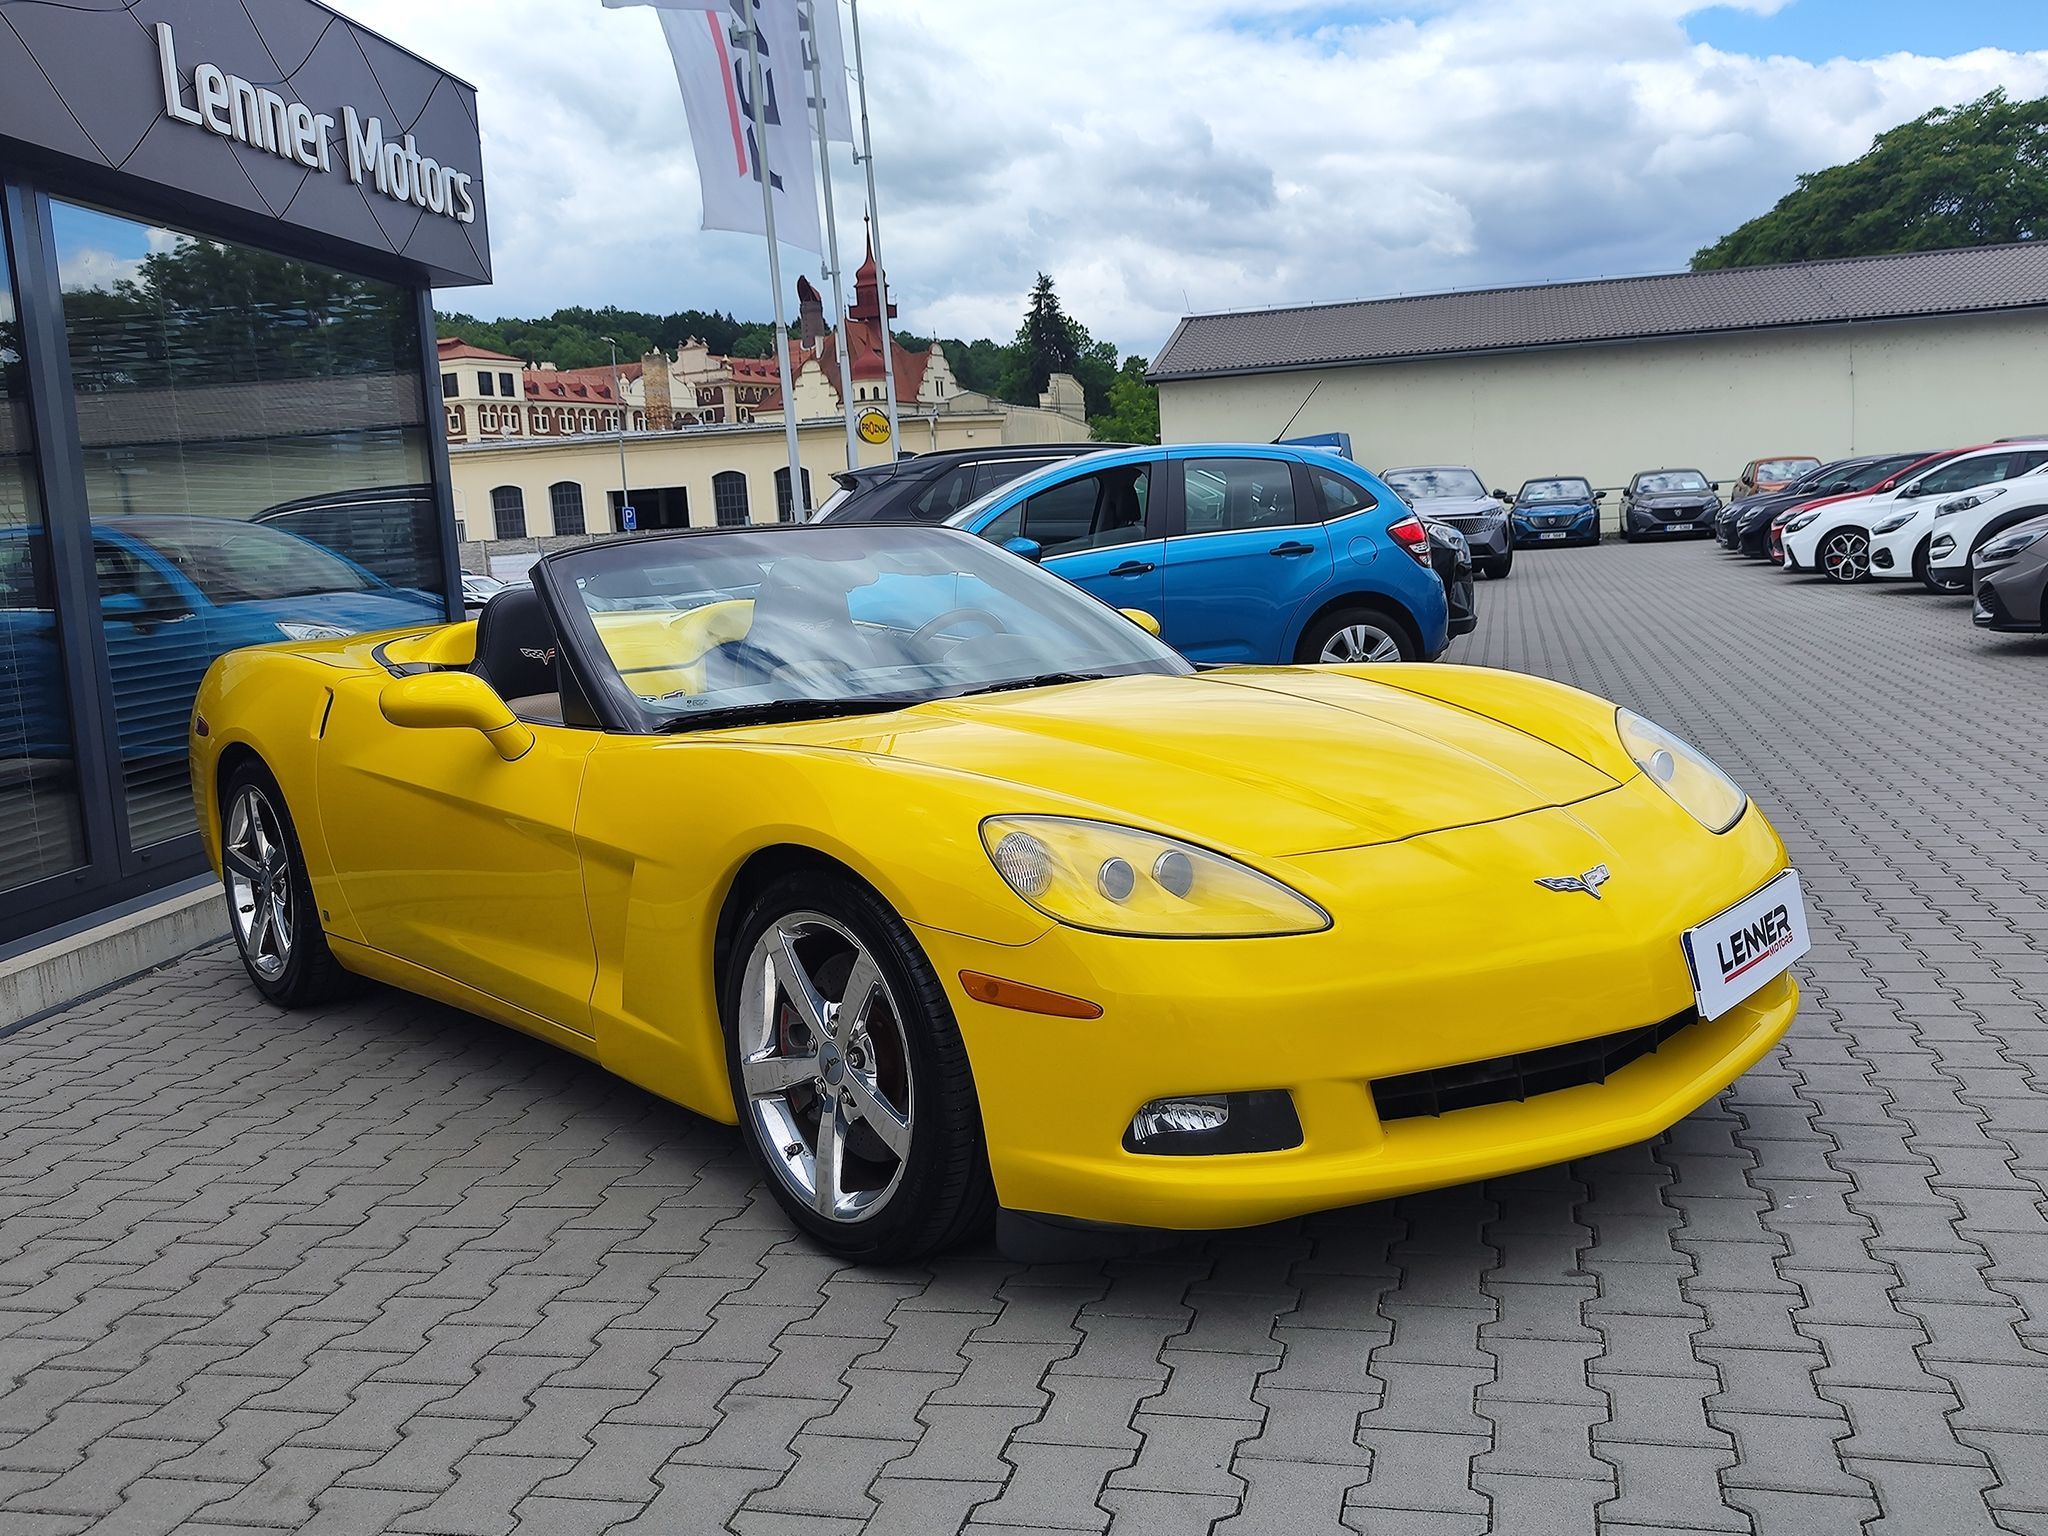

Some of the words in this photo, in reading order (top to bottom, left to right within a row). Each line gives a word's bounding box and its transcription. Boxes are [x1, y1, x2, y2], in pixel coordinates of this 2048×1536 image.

[156, 21, 335, 174] Lenner
[341, 105, 476, 224] Motors
[861, 421, 889, 435] PROZNAK
[625, 510, 633, 523] P
[1716, 904, 1792, 975] LENNER
[1769, 931, 1794, 957] MOTORS
